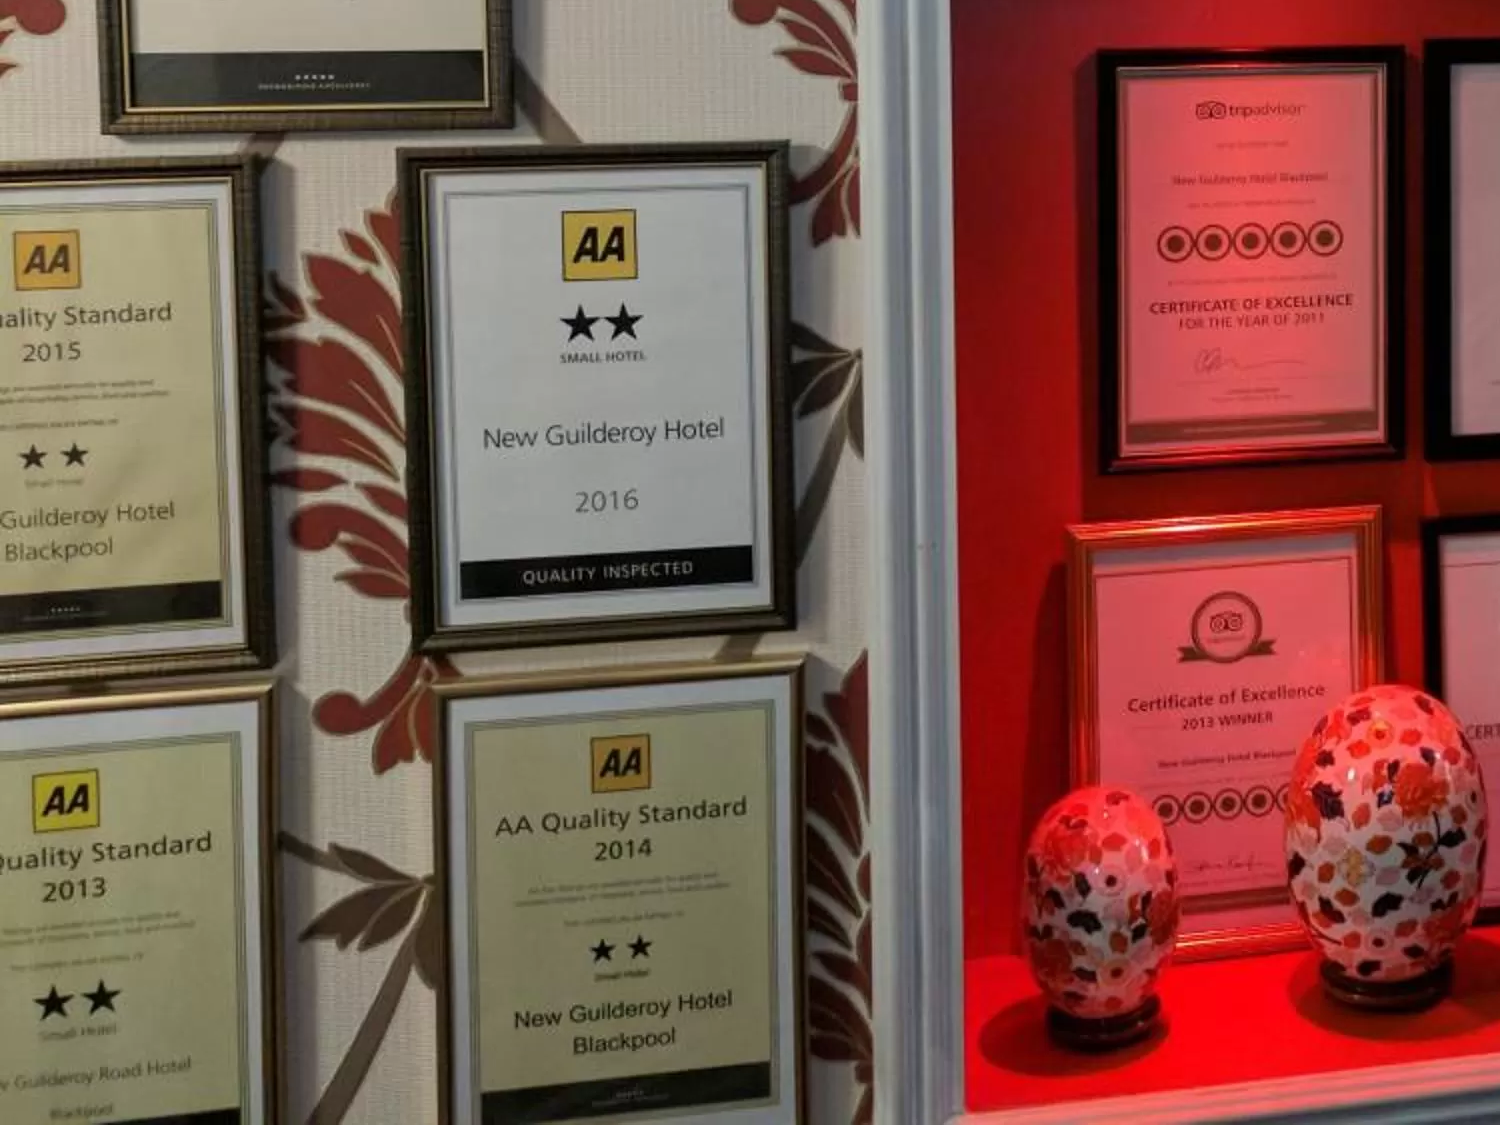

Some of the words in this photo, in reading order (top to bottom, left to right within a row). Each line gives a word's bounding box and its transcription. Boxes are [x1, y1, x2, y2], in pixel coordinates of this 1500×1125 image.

[24, 243, 71, 275] AA
[573, 226, 626, 264] AA
[0, 307, 57, 333] ality
[63, 302, 173, 327] Standard
[1149, 297, 1237, 316] CERTIFICATE
[1243, 298, 1261, 311] OF
[1265, 293, 1354, 310] EXCELLENCE
[1178, 318, 1205, 331] FOR
[1208, 316, 1233, 329] THE
[1237, 314, 1270, 328] YEAR
[1273, 313, 1291, 326] OF
[21, 341, 82, 363] 2015
[560, 351, 602, 365] SMALL
[605, 349, 648, 363] HOTEL
[483, 427, 537, 450] New
[545, 420, 658, 448] Guilderoy
[664, 417, 725, 442] Hotel
[0, 507, 108, 529] Guilderoy
[117, 501, 175, 523] Hotel
[575, 488, 640, 514] 2016
[5, 536, 114, 562] Blackpool
[522, 565, 597, 587] QUALITY
[603, 559, 694, 580] INSPECTED
[1127, 690, 1215, 713] Certificate
[1219, 688, 1237, 705] of
[1241, 683, 1326, 703] Excellence
[1181, 716, 1215, 732] 2013
[1218, 711, 1274, 727] WINNER
[600, 746, 642, 779] AA
[42, 783, 90, 817] AA
[495, 815, 534, 838] AA
[541, 805, 632, 835] Quality
[638, 795, 748, 826] Standard
[0, 845, 83, 874] uality
[91, 830, 212, 863] Standard
[593, 838, 654, 862] 2014
[41, 876, 108, 903] 2013
[514, 1008, 562, 1031] New
[568, 995, 672, 1024] Guilderoy
[677, 989, 734, 1013] Hotel
[572, 1026, 676, 1055] Blackpool
[14, 1069, 94, 1092] Guilderoy
[99, 1061, 143, 1083] Road
[147, 1055, 192, 1077] Hotel
